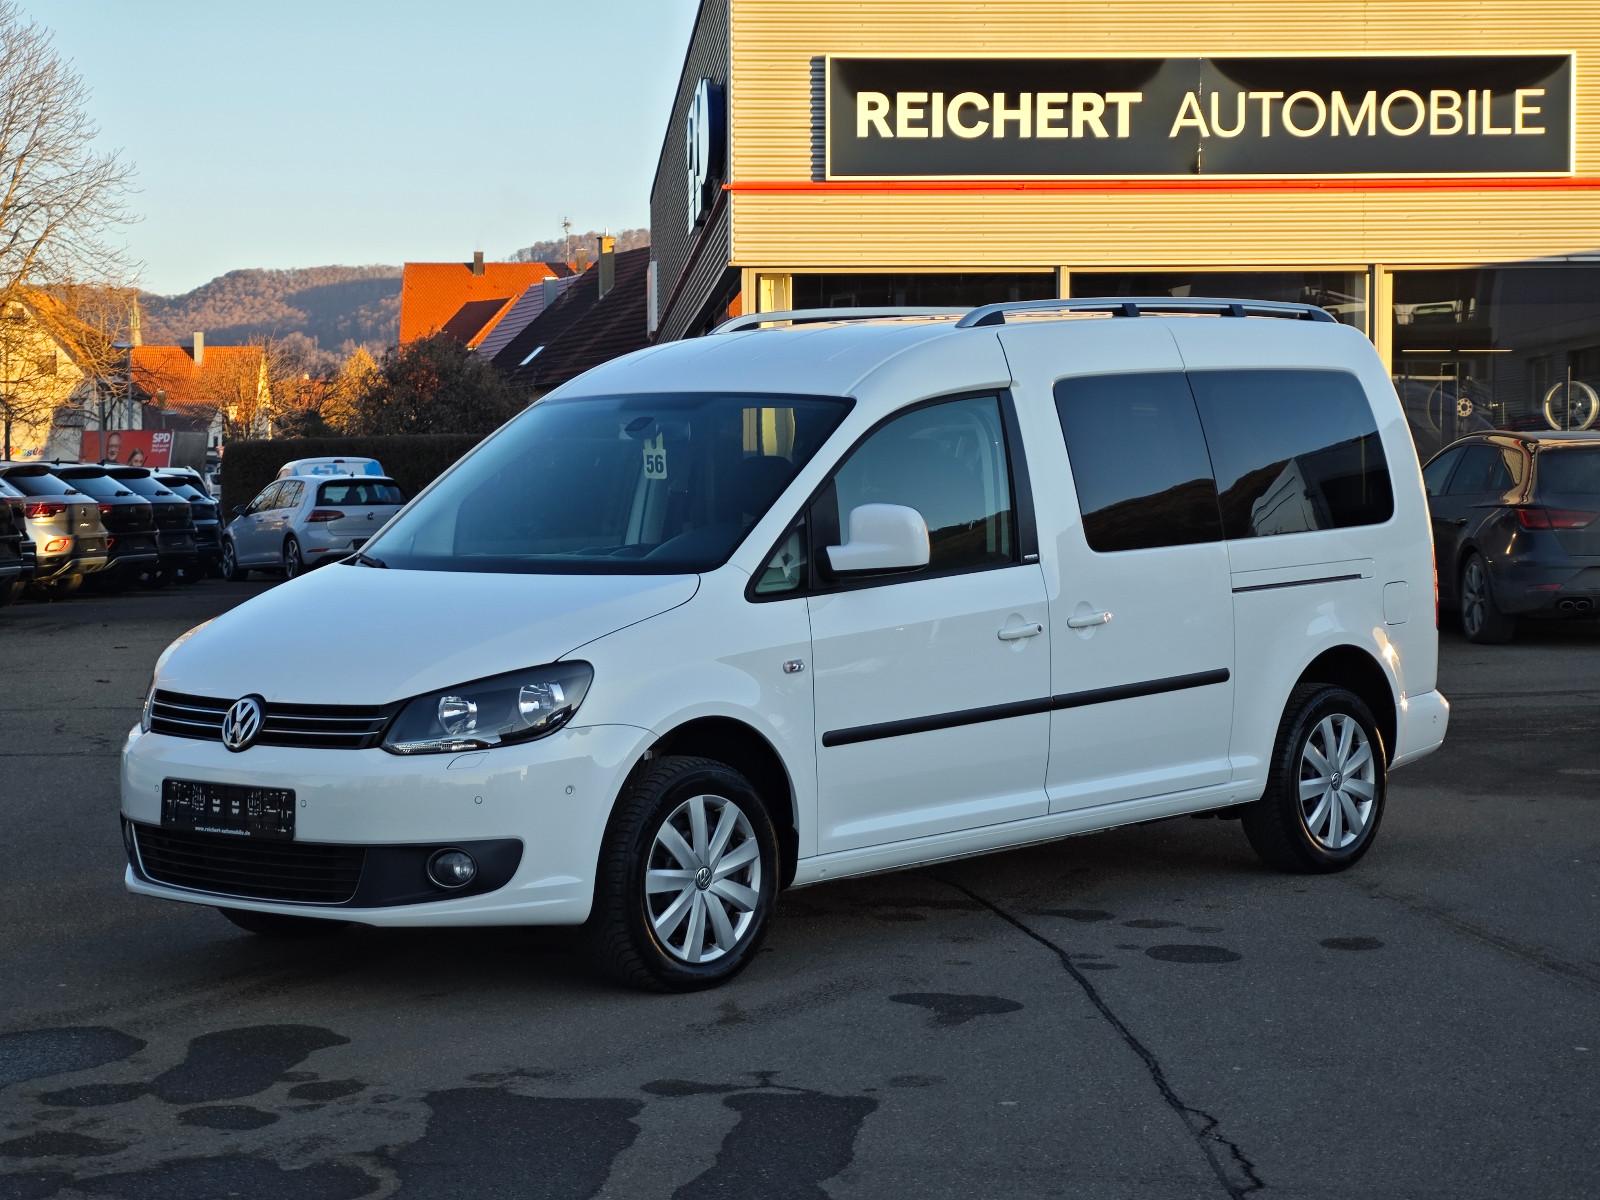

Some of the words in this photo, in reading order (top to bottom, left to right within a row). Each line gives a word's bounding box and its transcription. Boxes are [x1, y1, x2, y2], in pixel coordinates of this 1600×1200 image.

[856, 91, 1143, 139] REICHERT
[1169, 88, 1547, 138] AUTOMOBILE
[152, 432, 171, 443] SPD
[646, 454, 664, 474] 56
